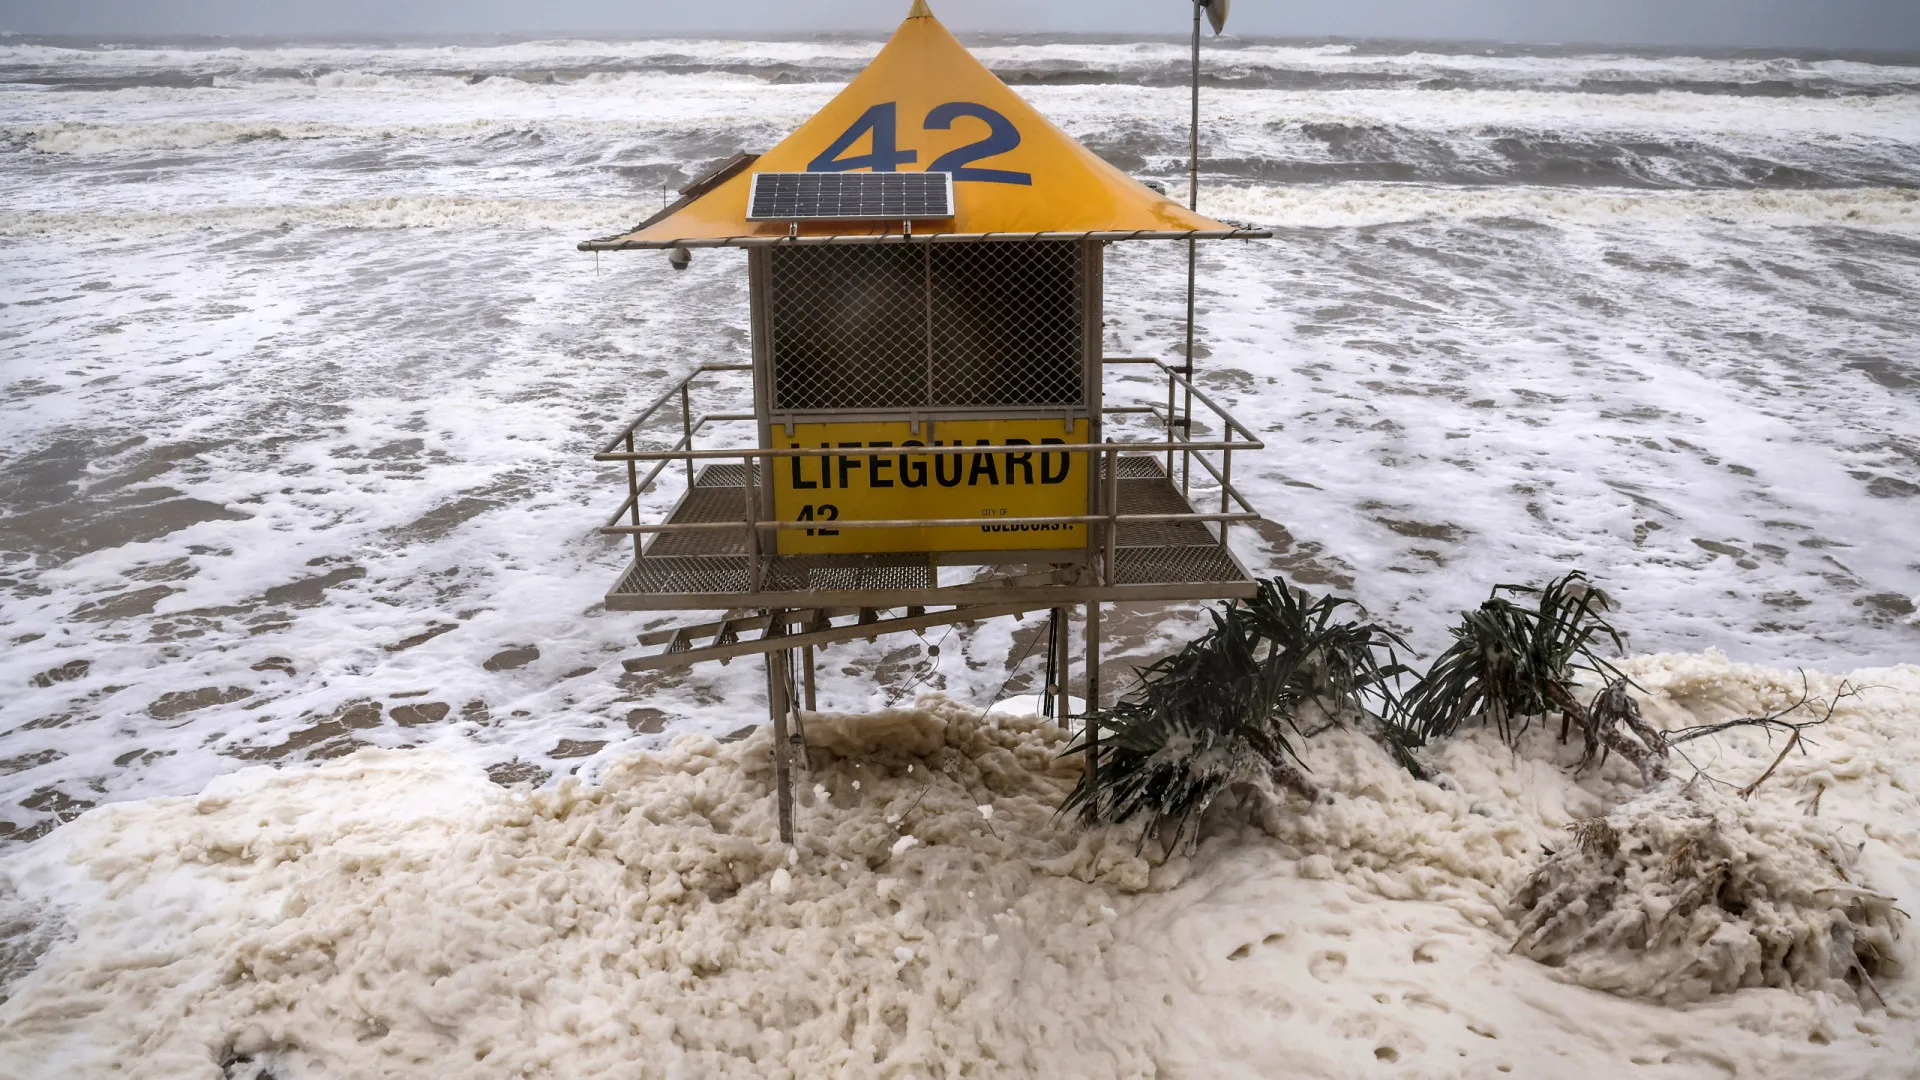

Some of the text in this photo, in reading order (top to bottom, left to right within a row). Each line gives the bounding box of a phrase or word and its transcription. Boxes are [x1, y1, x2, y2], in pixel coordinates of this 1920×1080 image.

[806, 102, 1032, 186] 42
[791, 438, 1071, 489] LIFEGUARD
[796, 504, 839, 536] 42
